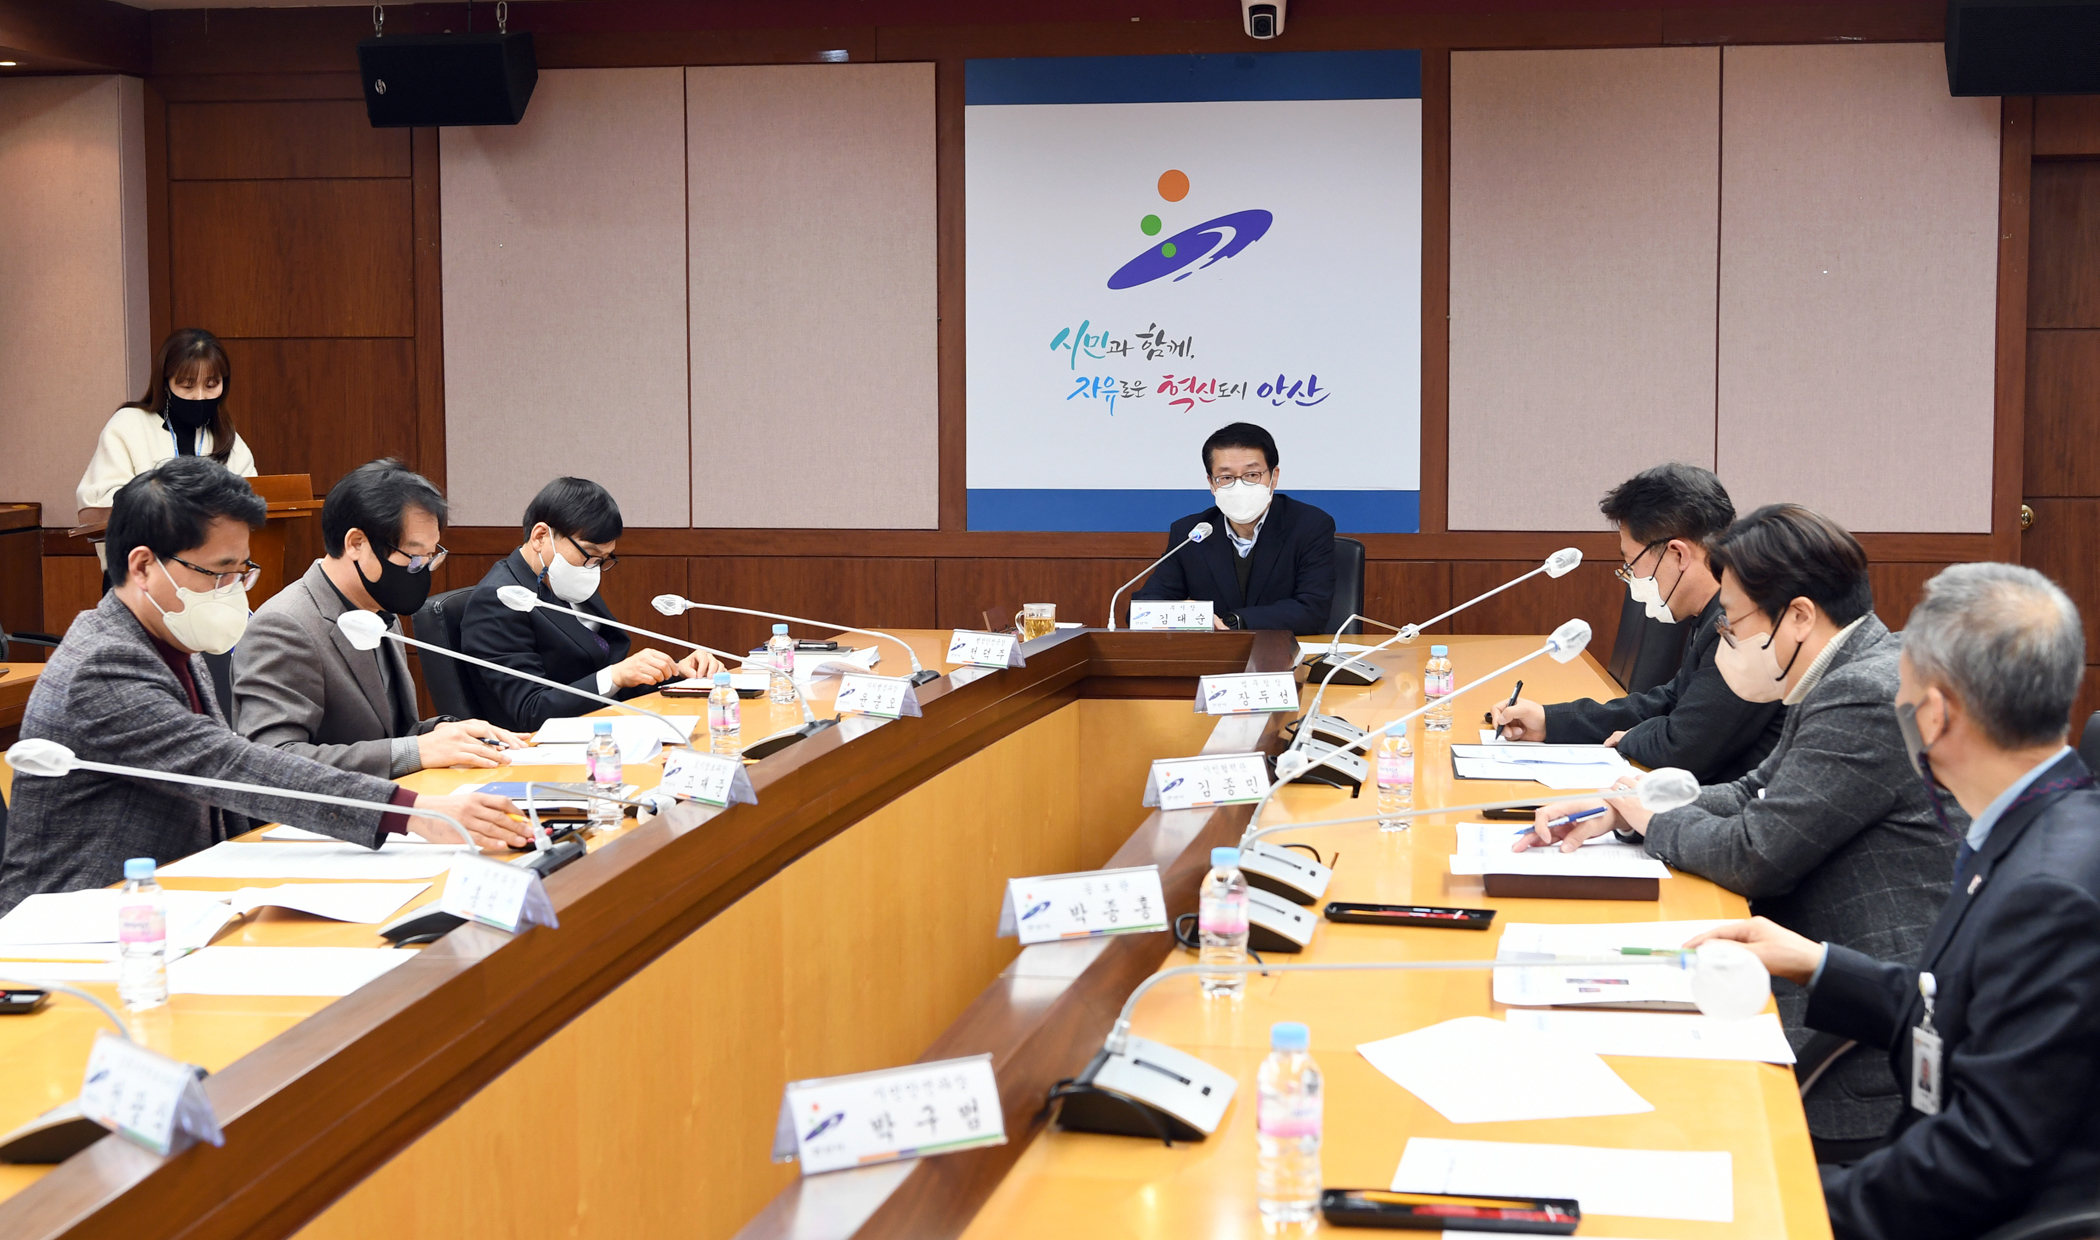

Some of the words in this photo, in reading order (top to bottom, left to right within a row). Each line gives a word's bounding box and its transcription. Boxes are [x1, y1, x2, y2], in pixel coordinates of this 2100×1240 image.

[1050, 319, 1134, 370] 시민과
[1066, 375, 1148, 416] 자유로운
[1156, 374, 1248, 413] 혁신도시
[1256, 373, 1331, 407] 안산
[1238, 689, 1289, 707] 장두성
[1198, 775, 1259, 798] 김종민
